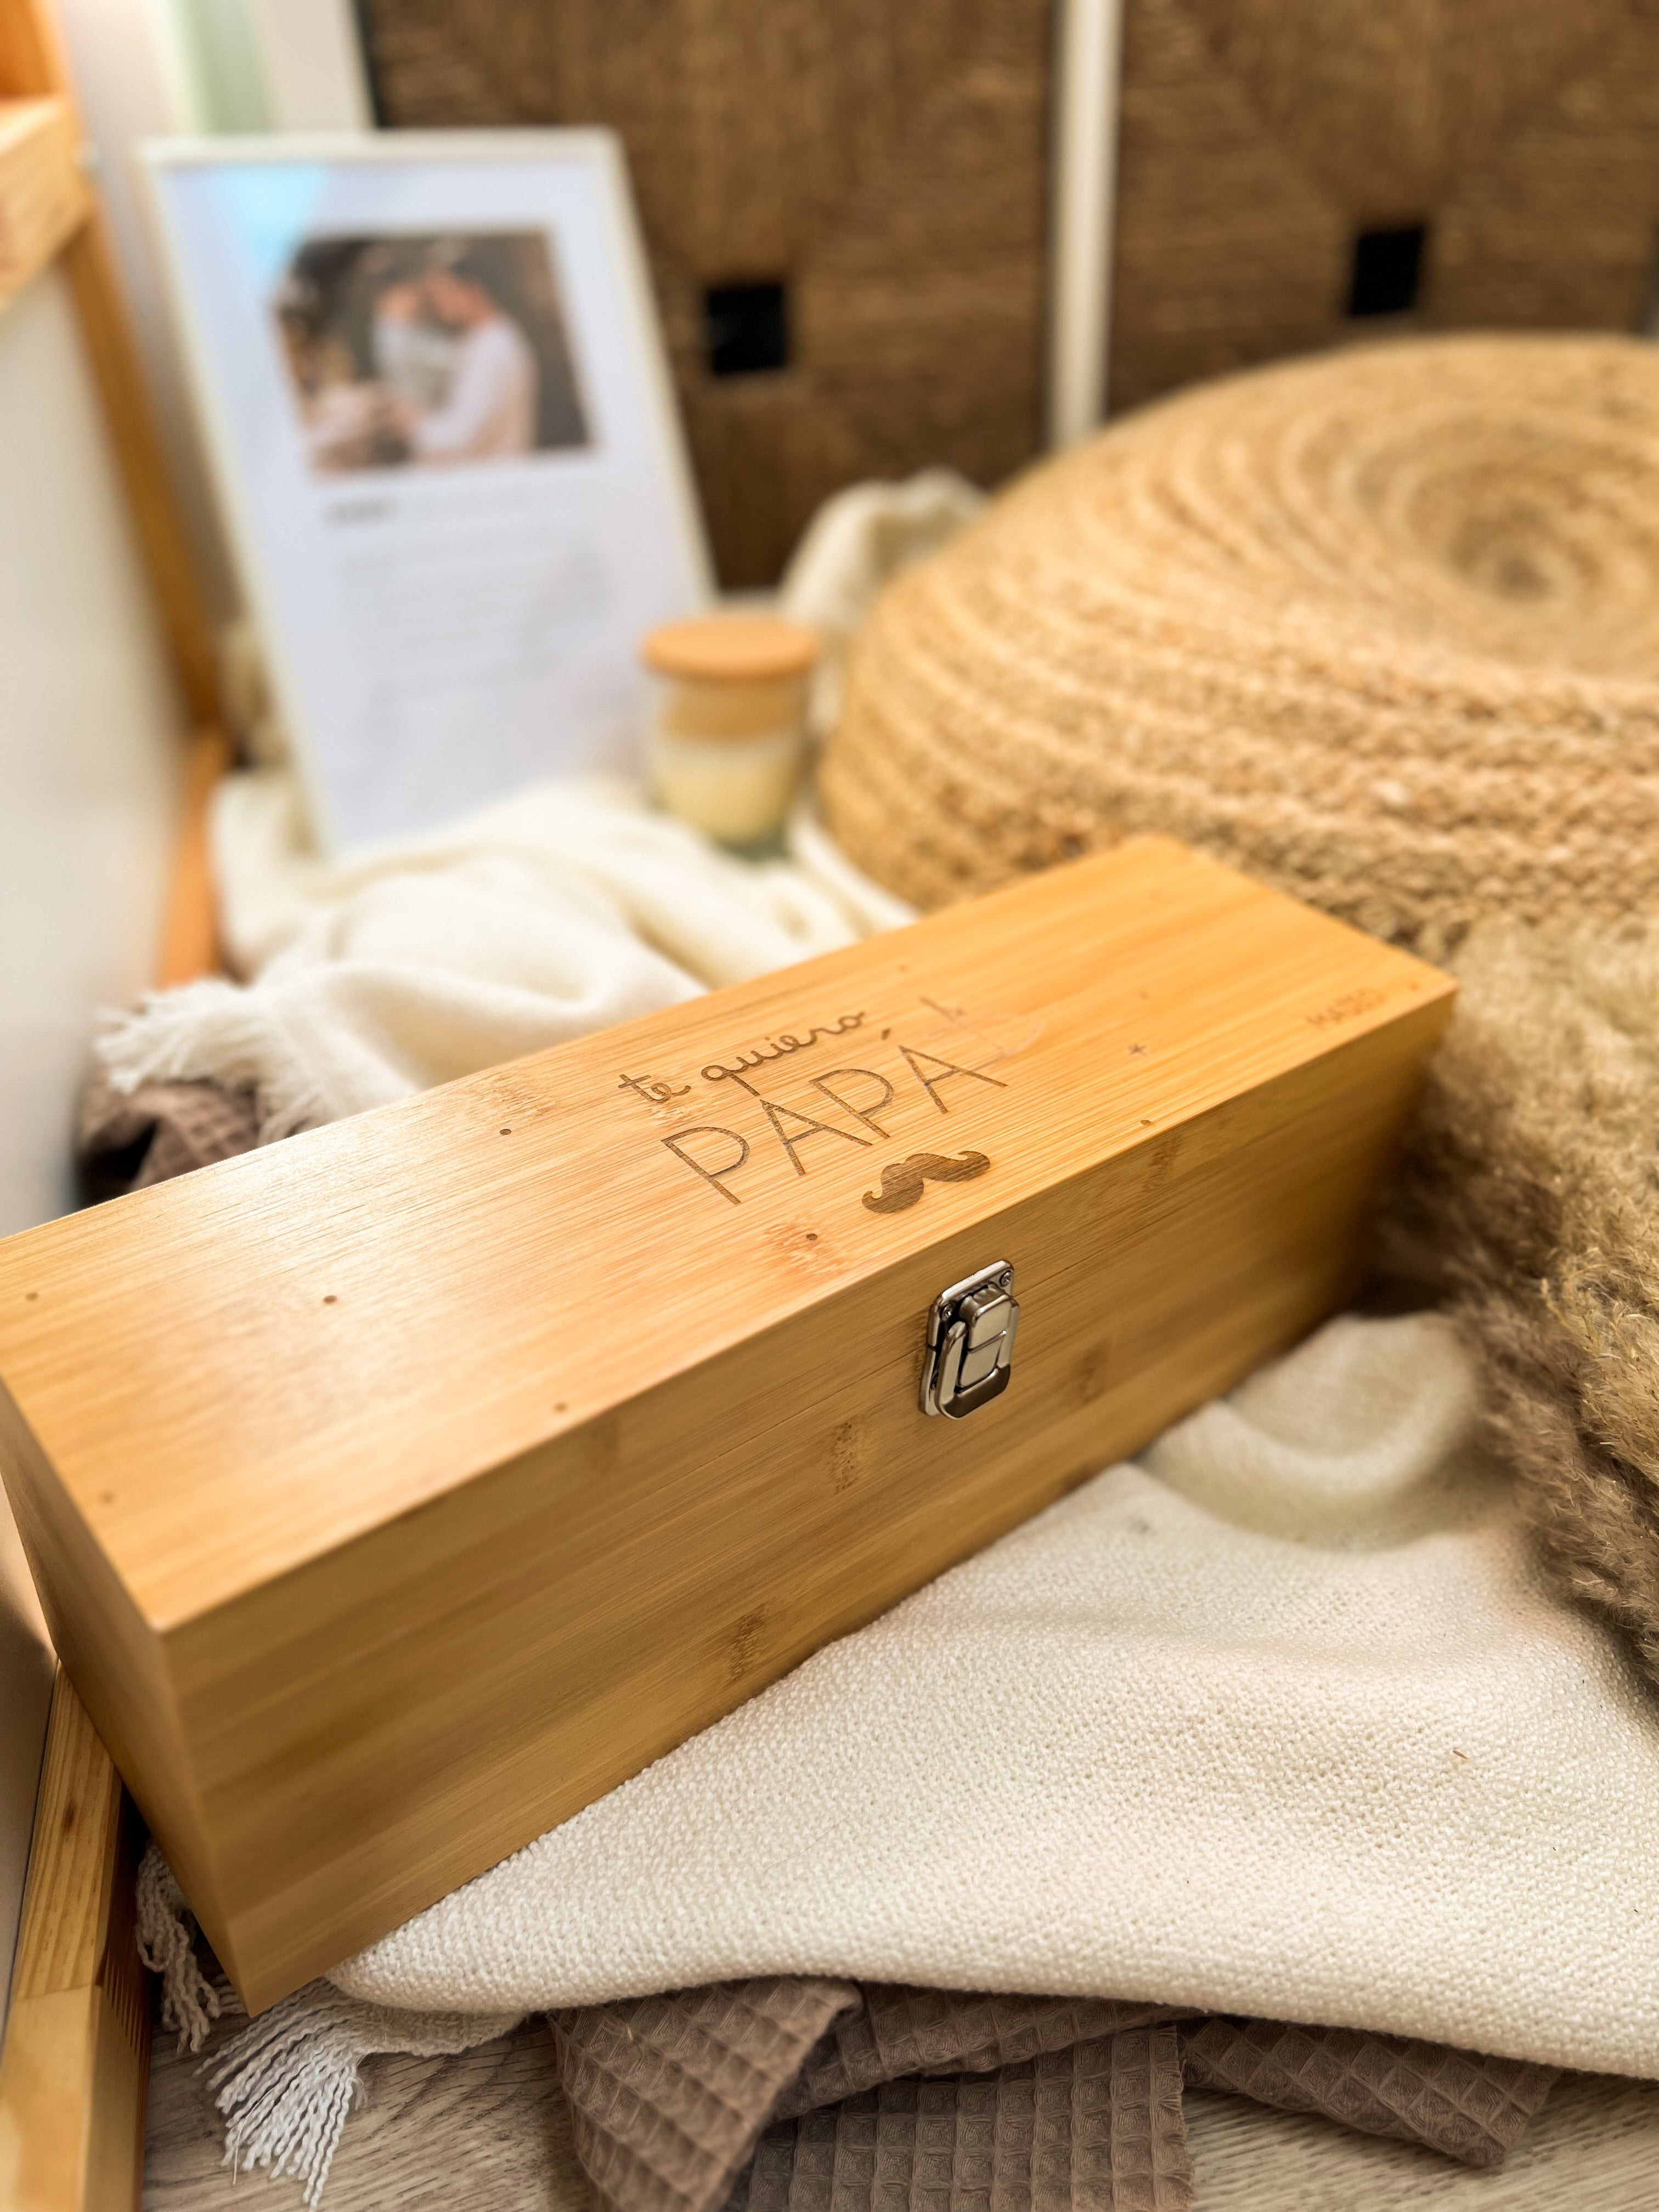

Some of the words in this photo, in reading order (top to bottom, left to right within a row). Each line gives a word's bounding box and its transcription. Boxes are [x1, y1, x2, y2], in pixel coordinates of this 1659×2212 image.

[618, 1073, 691, 1103] te
[699, 1011, 866, 1097] quiero
[661, 1027, 1008, 1205] PAPÁ
